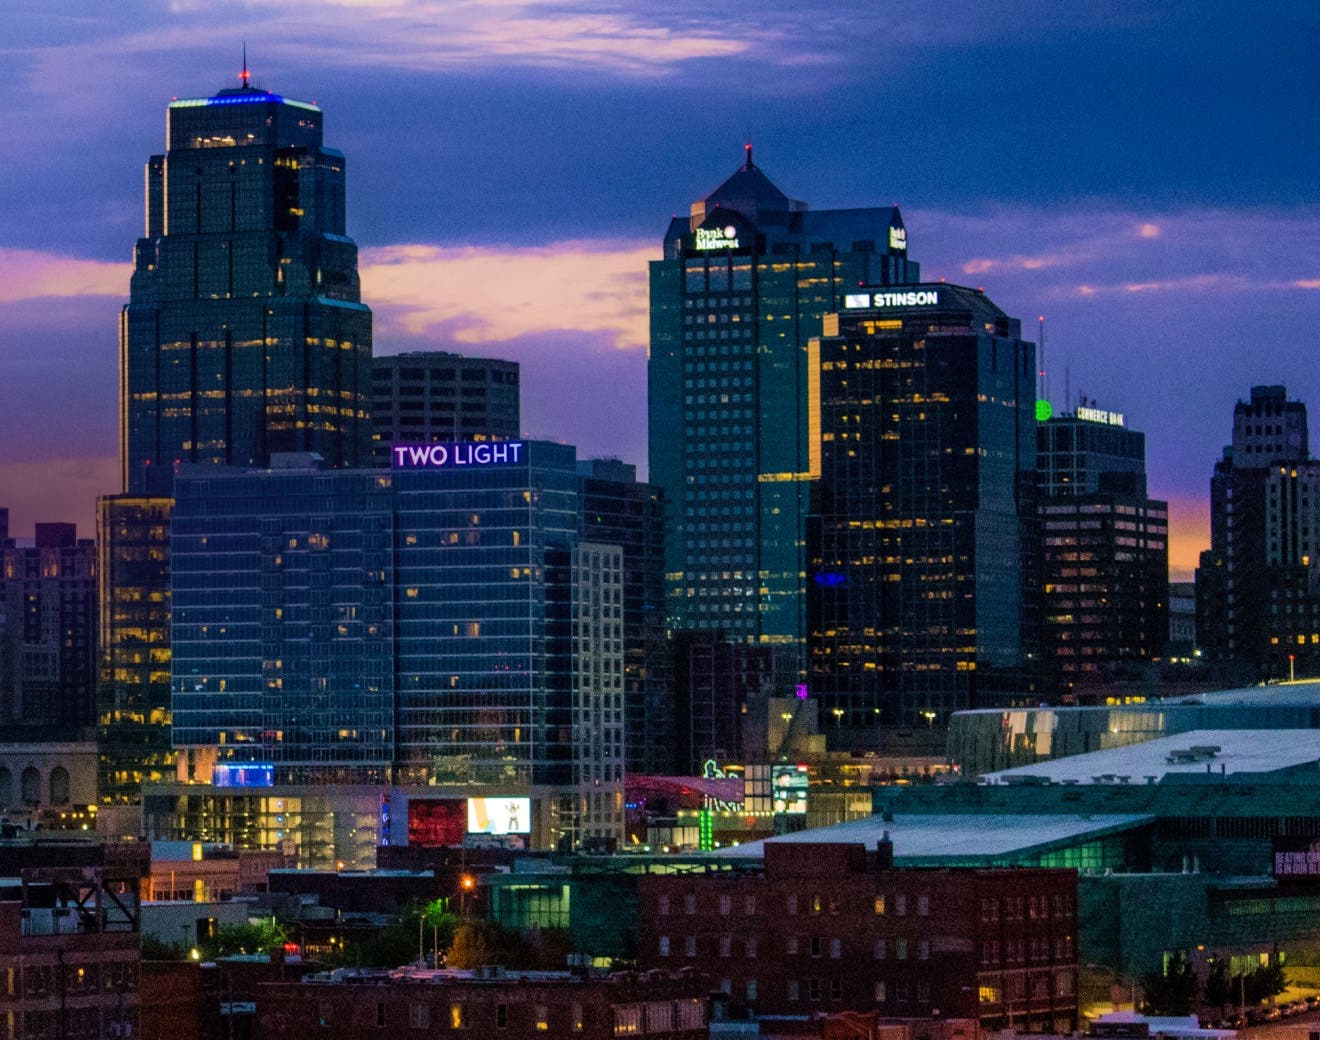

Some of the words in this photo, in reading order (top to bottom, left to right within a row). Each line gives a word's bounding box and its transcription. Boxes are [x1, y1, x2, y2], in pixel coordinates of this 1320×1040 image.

[696, 227, 724, 239] Bank
[696, 238, 740, 250] Midwest
[873, 292, 938, 307] STINSON
[1077, 406, 1108, 424] COMMERCE
[1109, 411, 1124, 426] BANK
[394, 445, 448, 466] TWO
[455, 443, 522, 464] LIGHT
